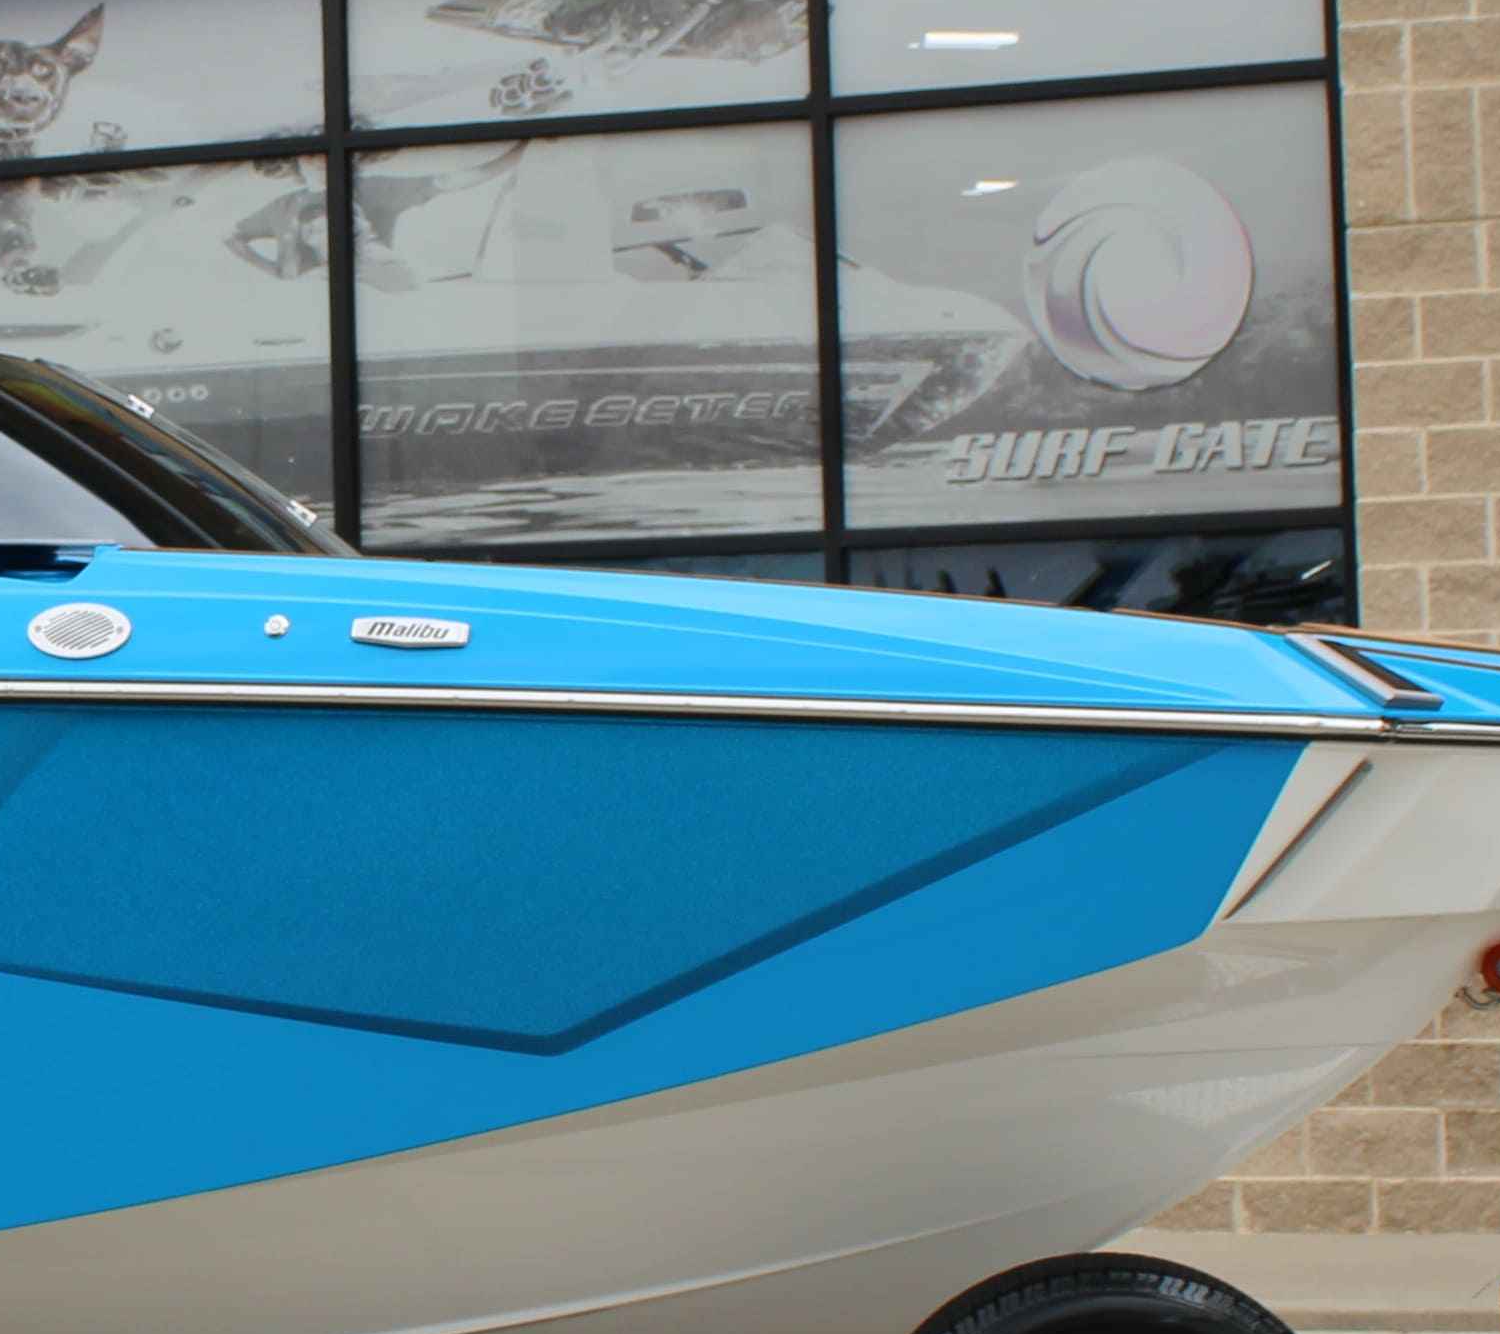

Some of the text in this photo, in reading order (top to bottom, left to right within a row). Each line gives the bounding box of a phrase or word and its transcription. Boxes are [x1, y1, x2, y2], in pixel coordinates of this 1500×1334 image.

[945, 415, 1340, 483] SURF GATE
[367, 621, 450, 639] Malibu
